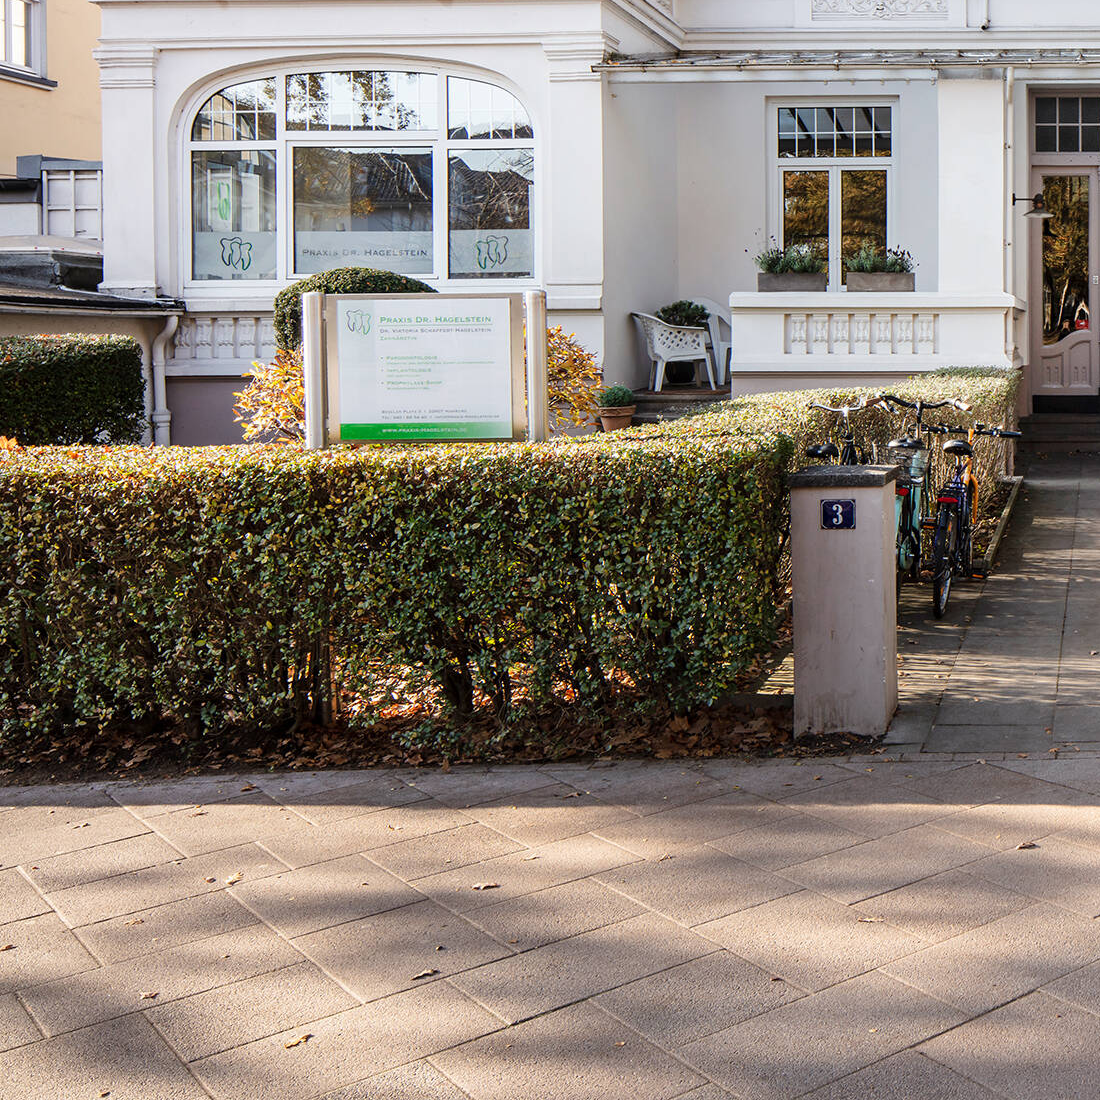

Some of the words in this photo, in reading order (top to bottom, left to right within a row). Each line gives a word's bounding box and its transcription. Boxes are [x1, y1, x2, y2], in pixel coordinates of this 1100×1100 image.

[302, 249, 338, 257] PRAXIS
[342, 249, 360, 257] DR.
[364, 249, 428, 257] HAGELSTEIN
[832, 503, 843, 525] 3
